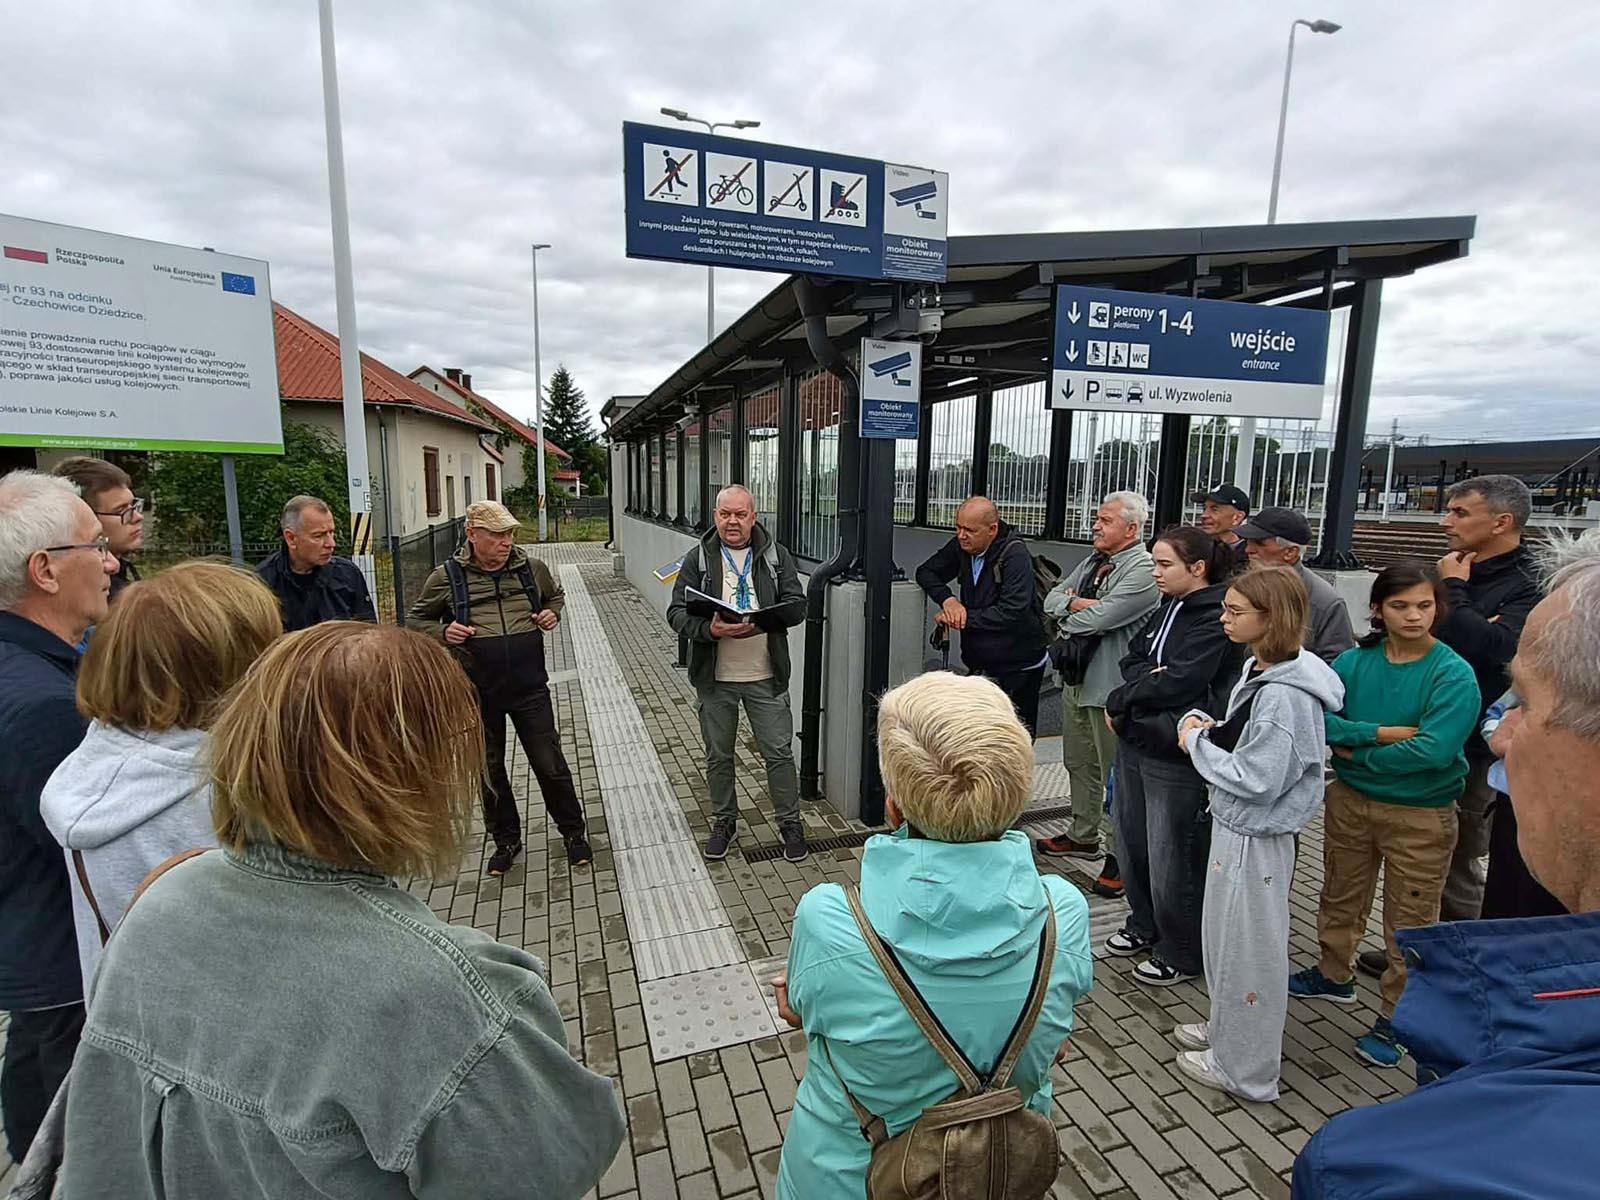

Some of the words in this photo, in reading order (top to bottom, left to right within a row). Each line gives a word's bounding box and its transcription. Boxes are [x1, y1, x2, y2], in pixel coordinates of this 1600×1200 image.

[681, 215, 700, 225] Zakaz
[701, 218, 718, 229] jazdy
[719, 220, 749, 231] rowerami,
[639, 219, 662, 231] innymi
[663, 223, 697, 234] pojazdami
[719, 229, 730, 238] lub
[788, 238, 800, 247] tym
[699, 237, 713, 245] oraz
[714, 238, 747, 249] poruszania
[901, 238, 929, 250] Obiekt
[55, 247, 125, 265] Rzeczpospolita
[56, 255, 87, 266] Polska
[776, 254, 802, 263] obszarze
[802, 256, 834, 267] kolejowym
[886, 245, 943, 261] monitorowany
[153, 264, 171, 274] Unia
[172, 267, 216, 281] Europejska
[12, 295, 85, 313] Czechowice
[14, 285, 26, 293] nr
[30, 286, 46, 296] 93
[49, 289, 64, 299] na
[68, 291, 113, 306] odcinku
[1113, 305, 1155, 322] perony
[1158, 308, 1194, 336] 1-4
[1113, 321, 1140, 331] platforms
[30, 331, 97, 345] prowadzenia
[99, 338, 128, 348] ruchu
[130, 341, 177, 354] pociągów
[190, 348, 216, 358] ciągu
[1230, 328, 1296, 355] wejście
[117, 349, 135, 358] linii
[137, 350, 183, 365] kolejowej
[185, 356, 198, 365] do
[200, 357, 246, 370] wymogów
[1132, 353, 1148, 361] WC
[1241, 359, 1281, 371] entrance
[56, 353, 151, 371] transeuropejskiego
[154, 363, 195, 373] systemu
[197, 366, 249, 380] kolejowego
[9, 371, 55, 382] poprawa
[57, 373, 92, 384] jakości
[94, 377, 122, 388] usług
[34, 362, 44, 370] w
[47, 363, 74, 373] skład
[76, 366, 161, 382] transeuropejskiej
[163, 373, 185, 382] sieci
[187, 375, 251, 390] transportowej
[1149, 386, 1162, 400] ul.
[1164, 386, 1232, 404] Wyzwolenia
[30, 406, 53, 415] Linie
[55, 407, 97, 418] Kolejowe
[868, 410, 913, 419] monitorowany
[880, 402, 902, 411] Obiekt
